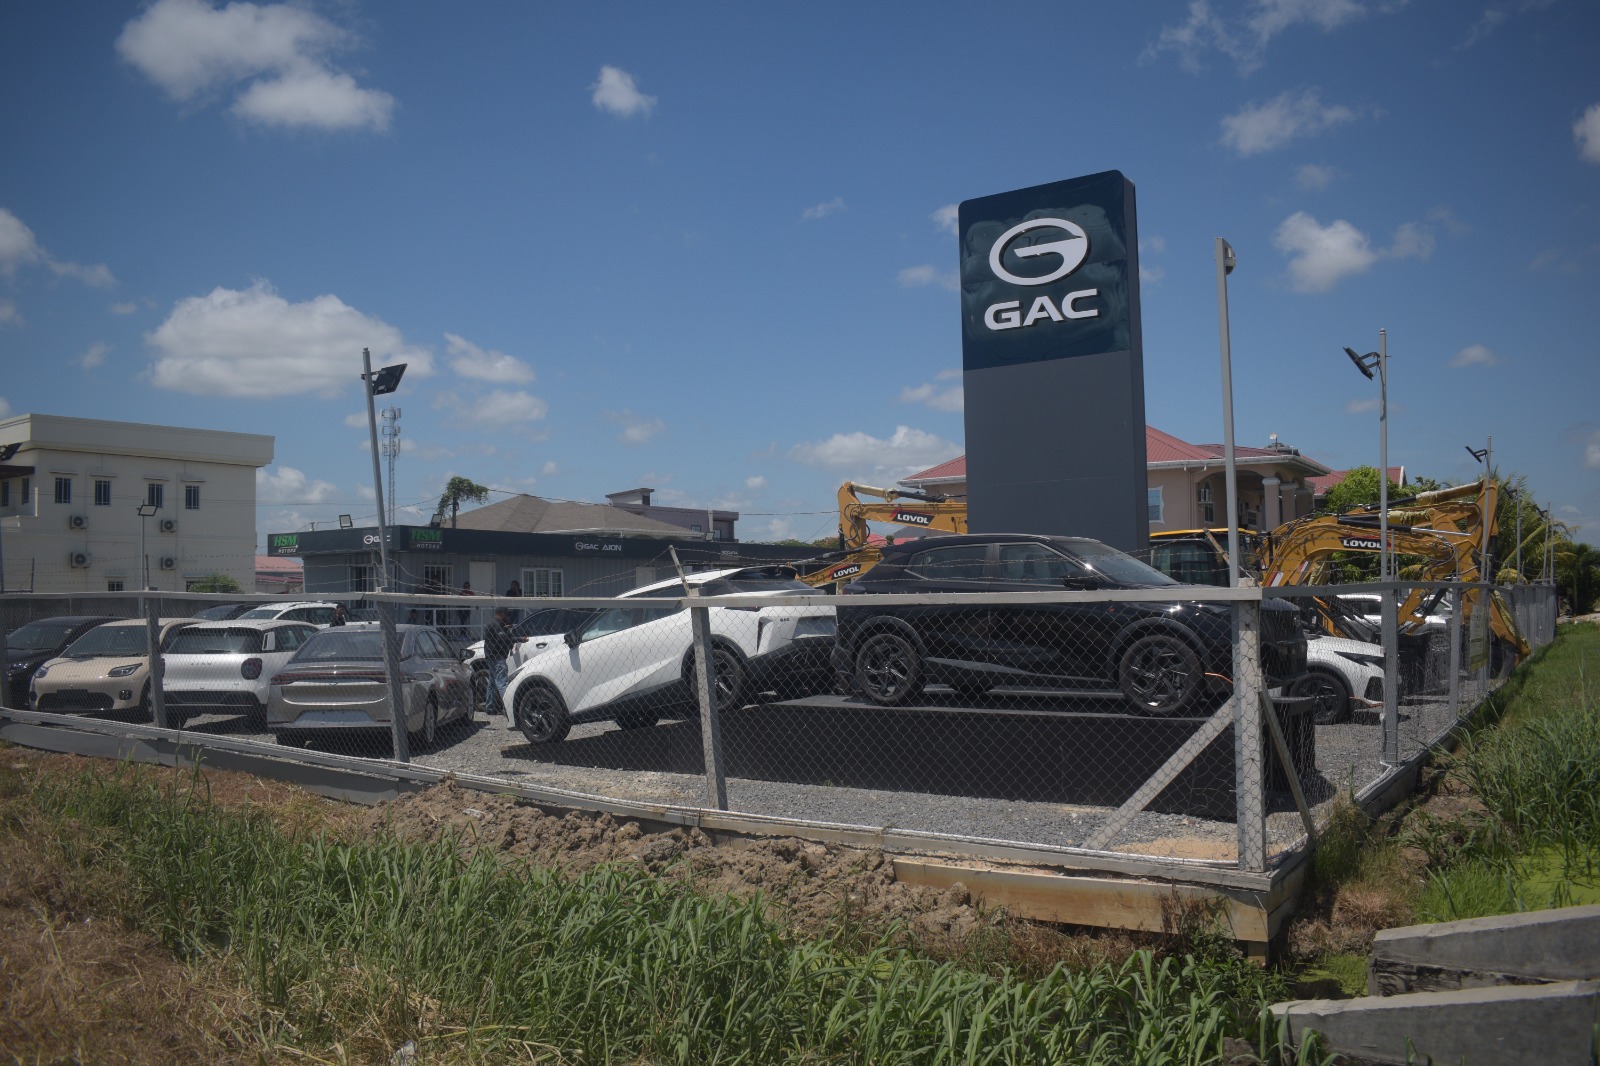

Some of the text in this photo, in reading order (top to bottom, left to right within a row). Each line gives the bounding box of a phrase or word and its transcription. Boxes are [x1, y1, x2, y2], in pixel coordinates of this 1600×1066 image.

[984, 288, 1098, 331] GAC
[897, 513, 929, 524] LOVOL
[274, 535, 298, 546] HSM
[1343, 539, 1382, 549] LOVOL
[833, 566, 860, 578] LOVOL
